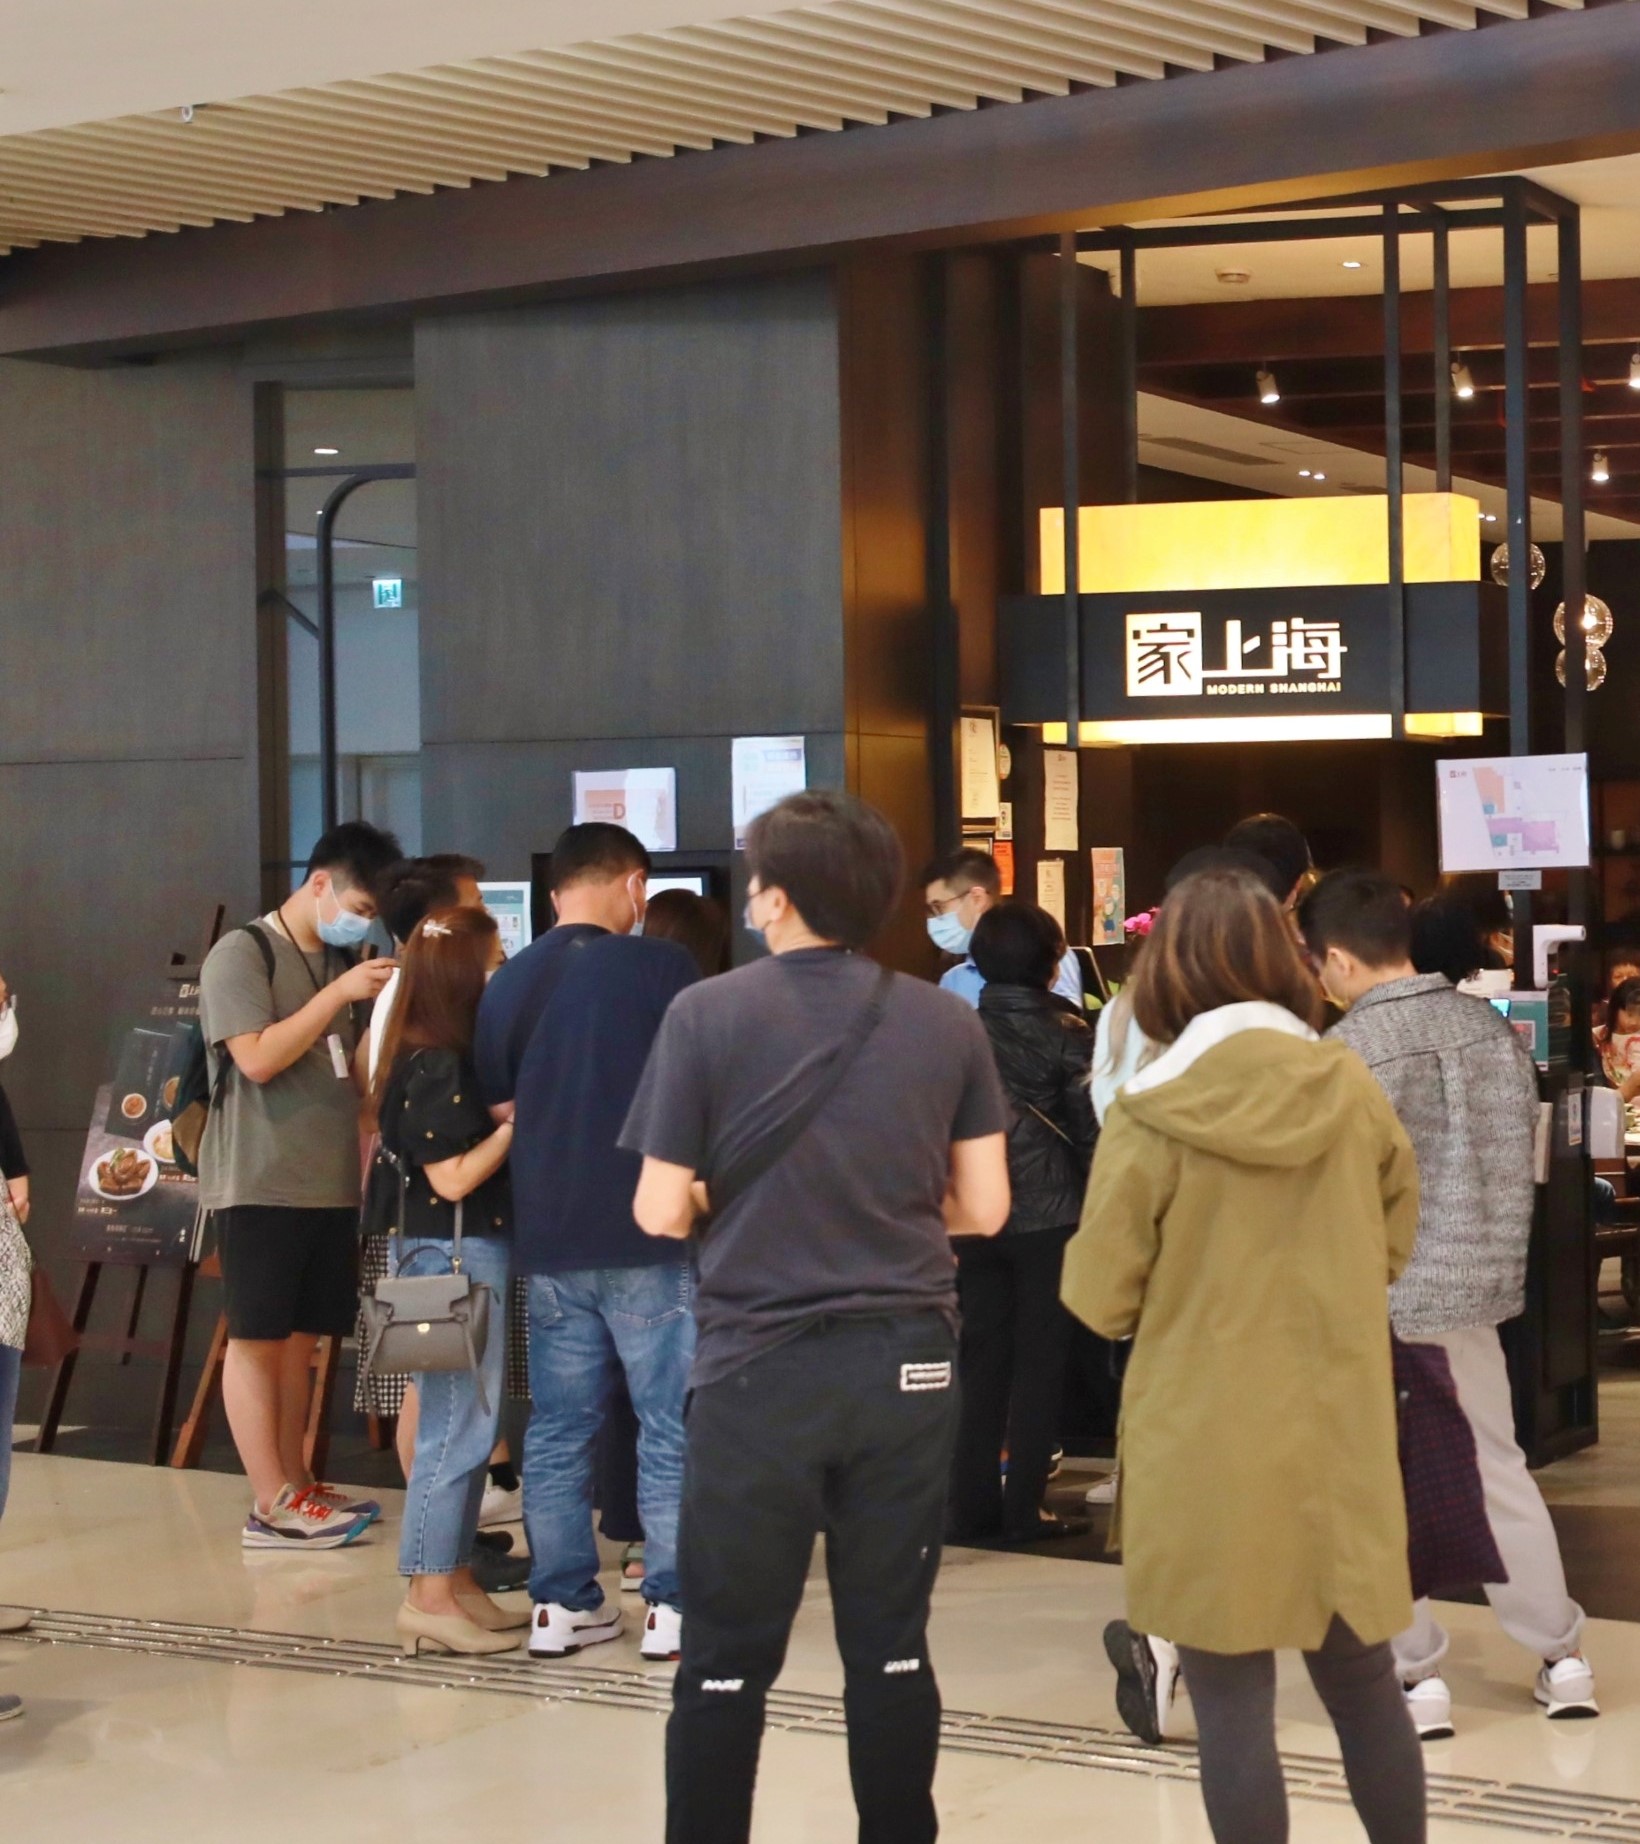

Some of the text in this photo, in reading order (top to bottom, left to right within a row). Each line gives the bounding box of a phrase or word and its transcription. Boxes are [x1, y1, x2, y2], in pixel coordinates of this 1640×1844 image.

[1127, 613, 1348, 692] 家上海
[1206, 682, 1341, 695] MODERN SHANGHAI
